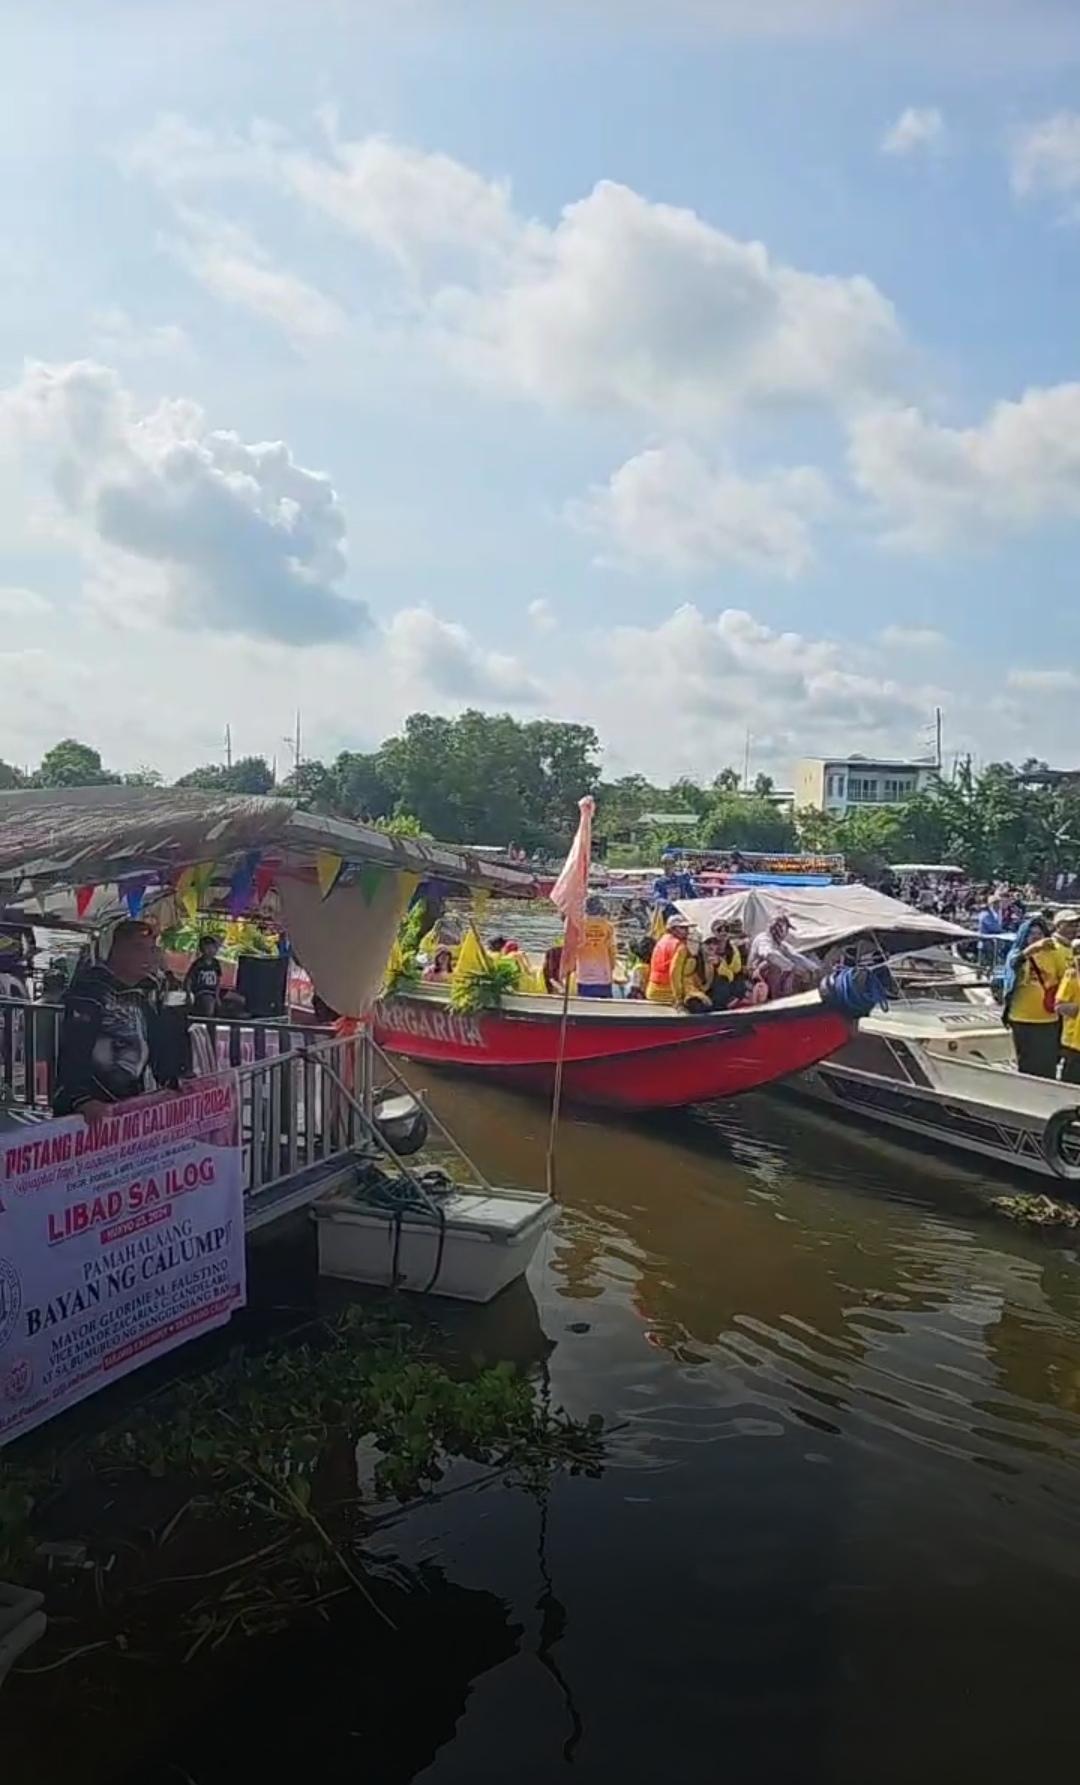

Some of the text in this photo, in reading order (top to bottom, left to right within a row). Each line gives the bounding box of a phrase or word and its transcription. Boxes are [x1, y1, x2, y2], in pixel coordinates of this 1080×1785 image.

[6, 1133, 71, 1179] PISTANG
[75, 1116, 120, 1157] BAYAN
[123, 1113, 140, 1140] NG
[204, 1086, 231, 1116] 2024
[48, 1191, 123, 1241] LIBAD
[128, 1178, 160, 1209] SA
[166, 1156, 215, 1194] ILOG
[26, 1281, 100, 1336] BAYAN
[107, 1261, 138, 1299] NG
[49, 1345, 75, 1367] VICE
[75, 1327, 111, 1354] MAYOR
[173, 1272, 228, 1303] CANDELARI
[51, 1319, 97, 1353] MAYOR
[171, 1258, 228, 1292] FAUSTINO
[122, 1325, 137, 1339] NG
